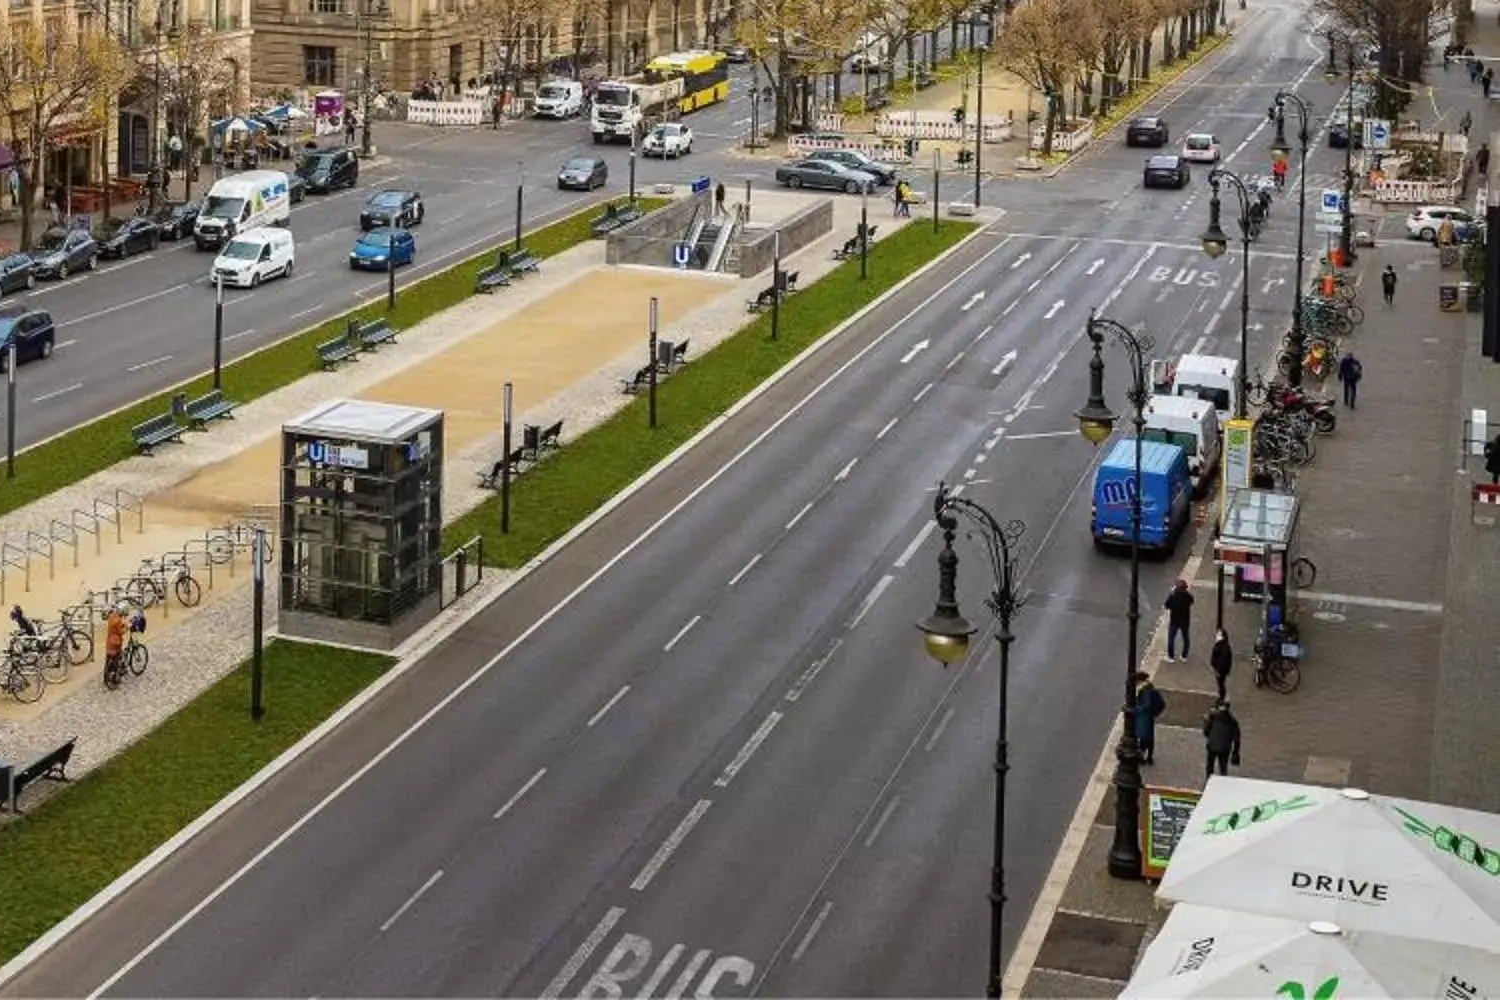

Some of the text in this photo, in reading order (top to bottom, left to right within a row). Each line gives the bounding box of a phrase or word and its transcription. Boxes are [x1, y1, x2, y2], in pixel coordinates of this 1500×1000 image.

[675, 246, 689, 263] U
[1147, 265, 1220, 287] BUS
[309, 443, 323, 461] U
[1291, 871, 1389, 902] DRIVE
